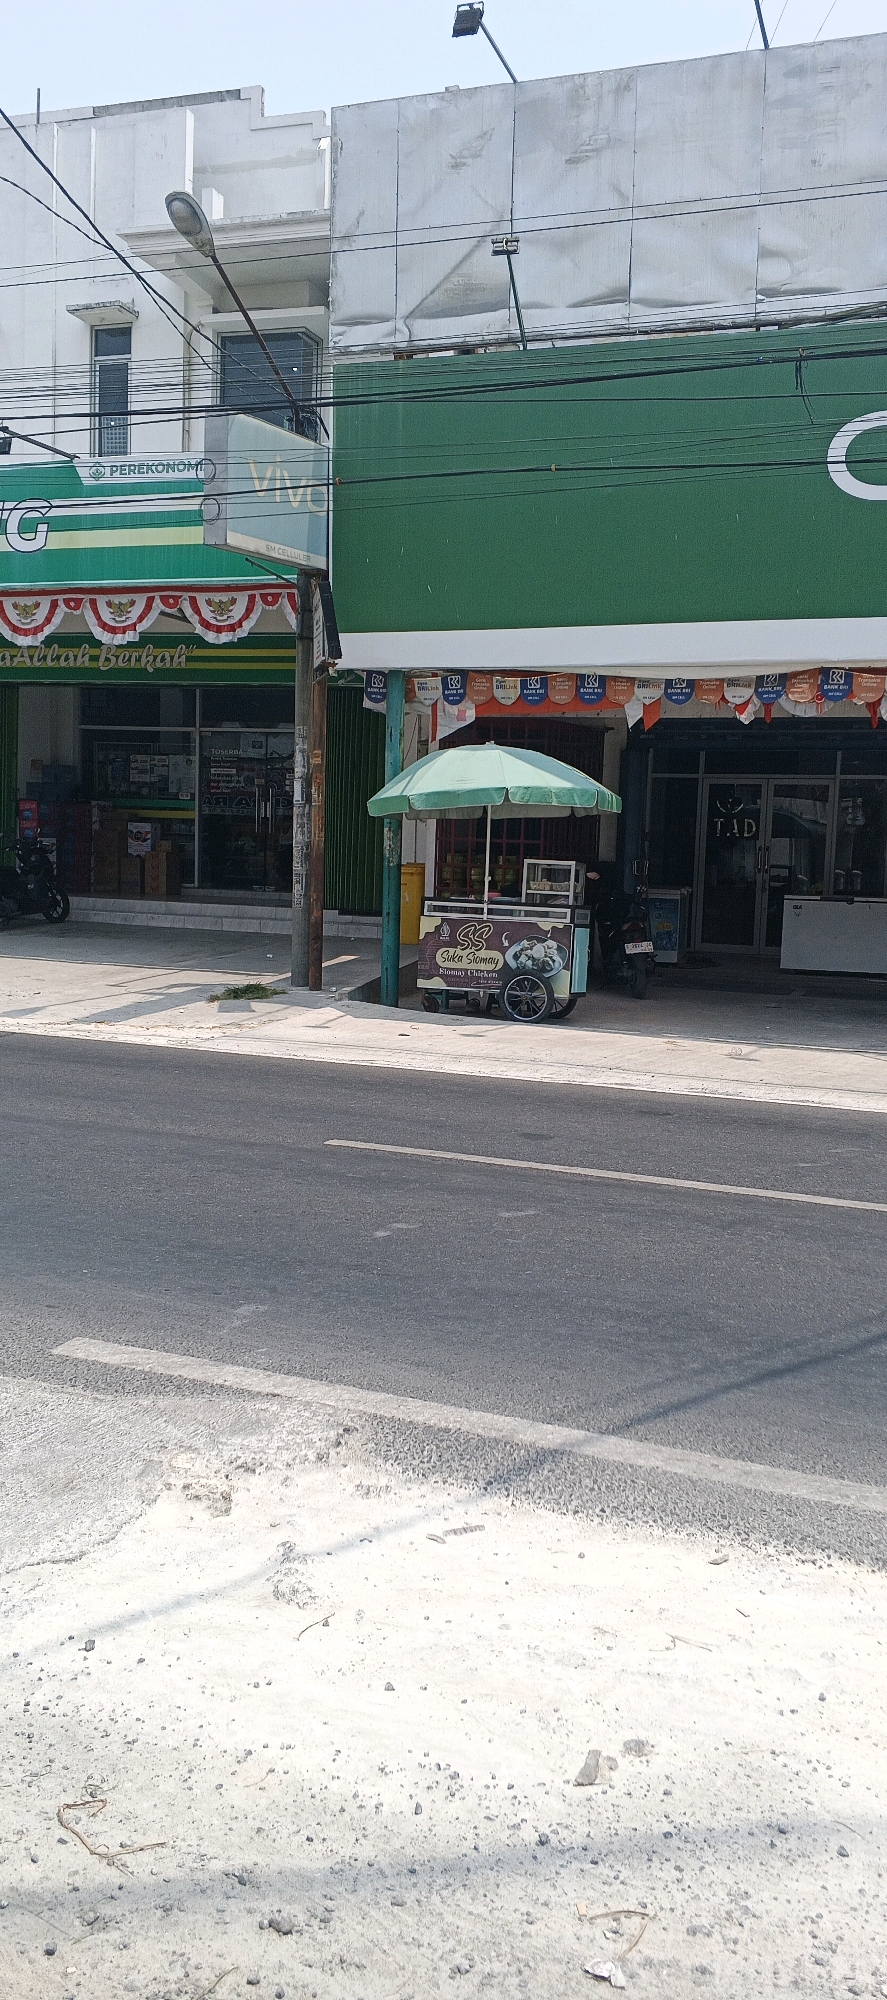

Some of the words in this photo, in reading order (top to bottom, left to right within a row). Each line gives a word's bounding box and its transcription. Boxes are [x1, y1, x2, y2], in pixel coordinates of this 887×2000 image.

[248, 454, 328, 516] vivo
[0, 498, 53, 554] G
[265, 544, 276, 552] SM
[277, 547, 312, 562] CELLULER
[457, 922, 493, 952] SS
[440, 950, 463, 964] Suka
[466, 951, 500, 970] Siomay
[439, 968, 465, 977] Siomay
[468, 970, 498, 978] Chicken
